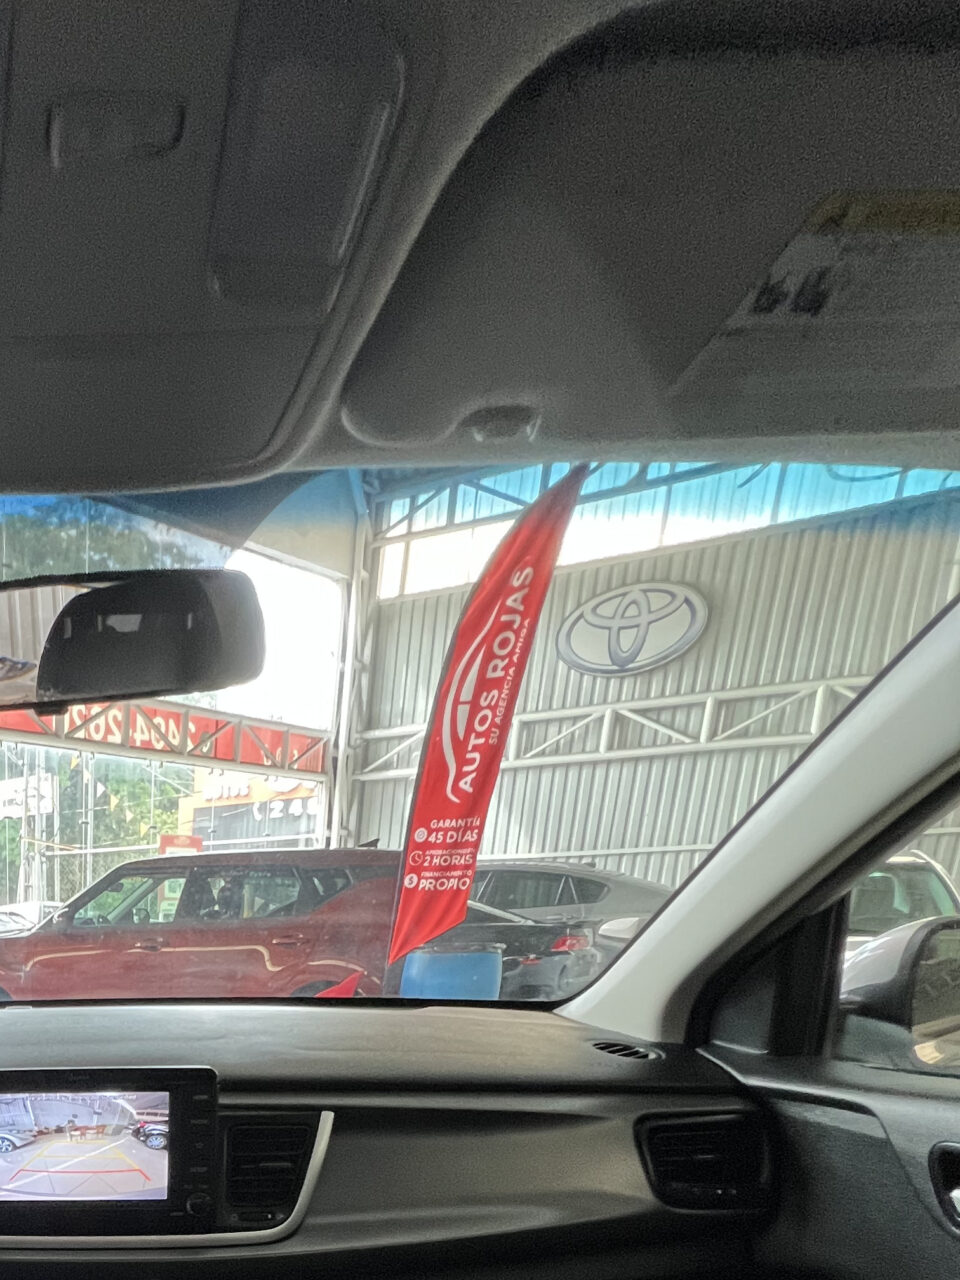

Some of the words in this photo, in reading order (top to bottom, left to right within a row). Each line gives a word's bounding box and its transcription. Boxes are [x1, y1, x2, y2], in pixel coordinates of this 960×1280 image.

[458, 688, 499, 793] AUTOS
[486, 566, 535, 680] ROJAS
[490, 727, 500, 745] SU
[496, 667, 517, 726] AGENCIA
[513, 617, 530, 664] AMIGA
[430, 816, 481, 829] GARANTÍA
[427, 831, 444, 844] 45
[446, 828, 479, 844] DÍAS
[423, 855, 431, 867] 2
[431, 854, 473, 867] HORAS
[418, 877, 471, 891] PROPIO
